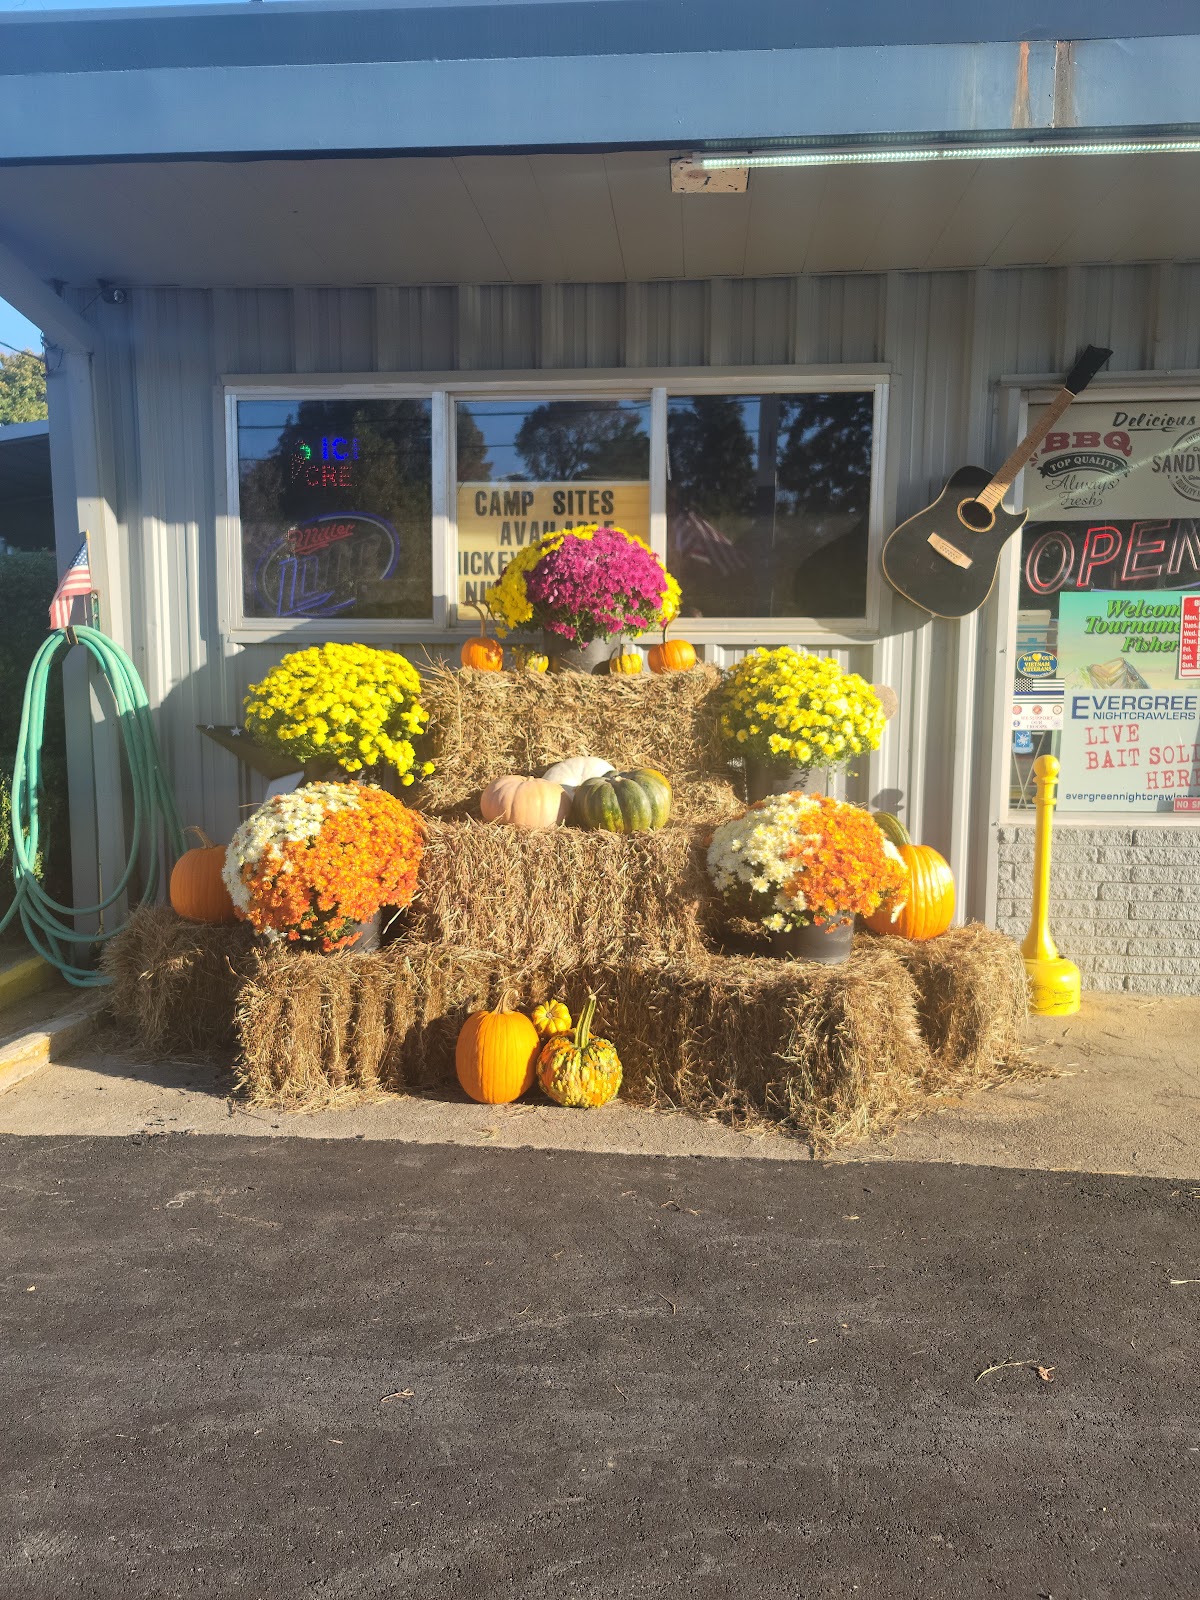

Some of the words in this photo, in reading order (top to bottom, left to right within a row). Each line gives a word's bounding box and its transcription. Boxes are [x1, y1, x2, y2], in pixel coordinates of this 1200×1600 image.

[1113, 412, 1196, 427] Delicious
[1041, 431, 1133, 457] BBQ
[1051, 460, 1071, 472] TOP
[1073, 456, 1119, 471] QUALITY
[1151, 454, 1200, 473] SAND
[1045, 474, 1120, 496] Always
[475, 490, 534, 517] CAMP
[552, 489, 615, 517] SITES
[1059, 491, 1103, 507] Fresh
[1093, 711, 1196, 720] NIGHTCRAWLERS
[1085, 723, 1140, 746] LIVE
[1085, 748, 1140, 770] BAIT
[1176, 801, 1189, 809] NO
